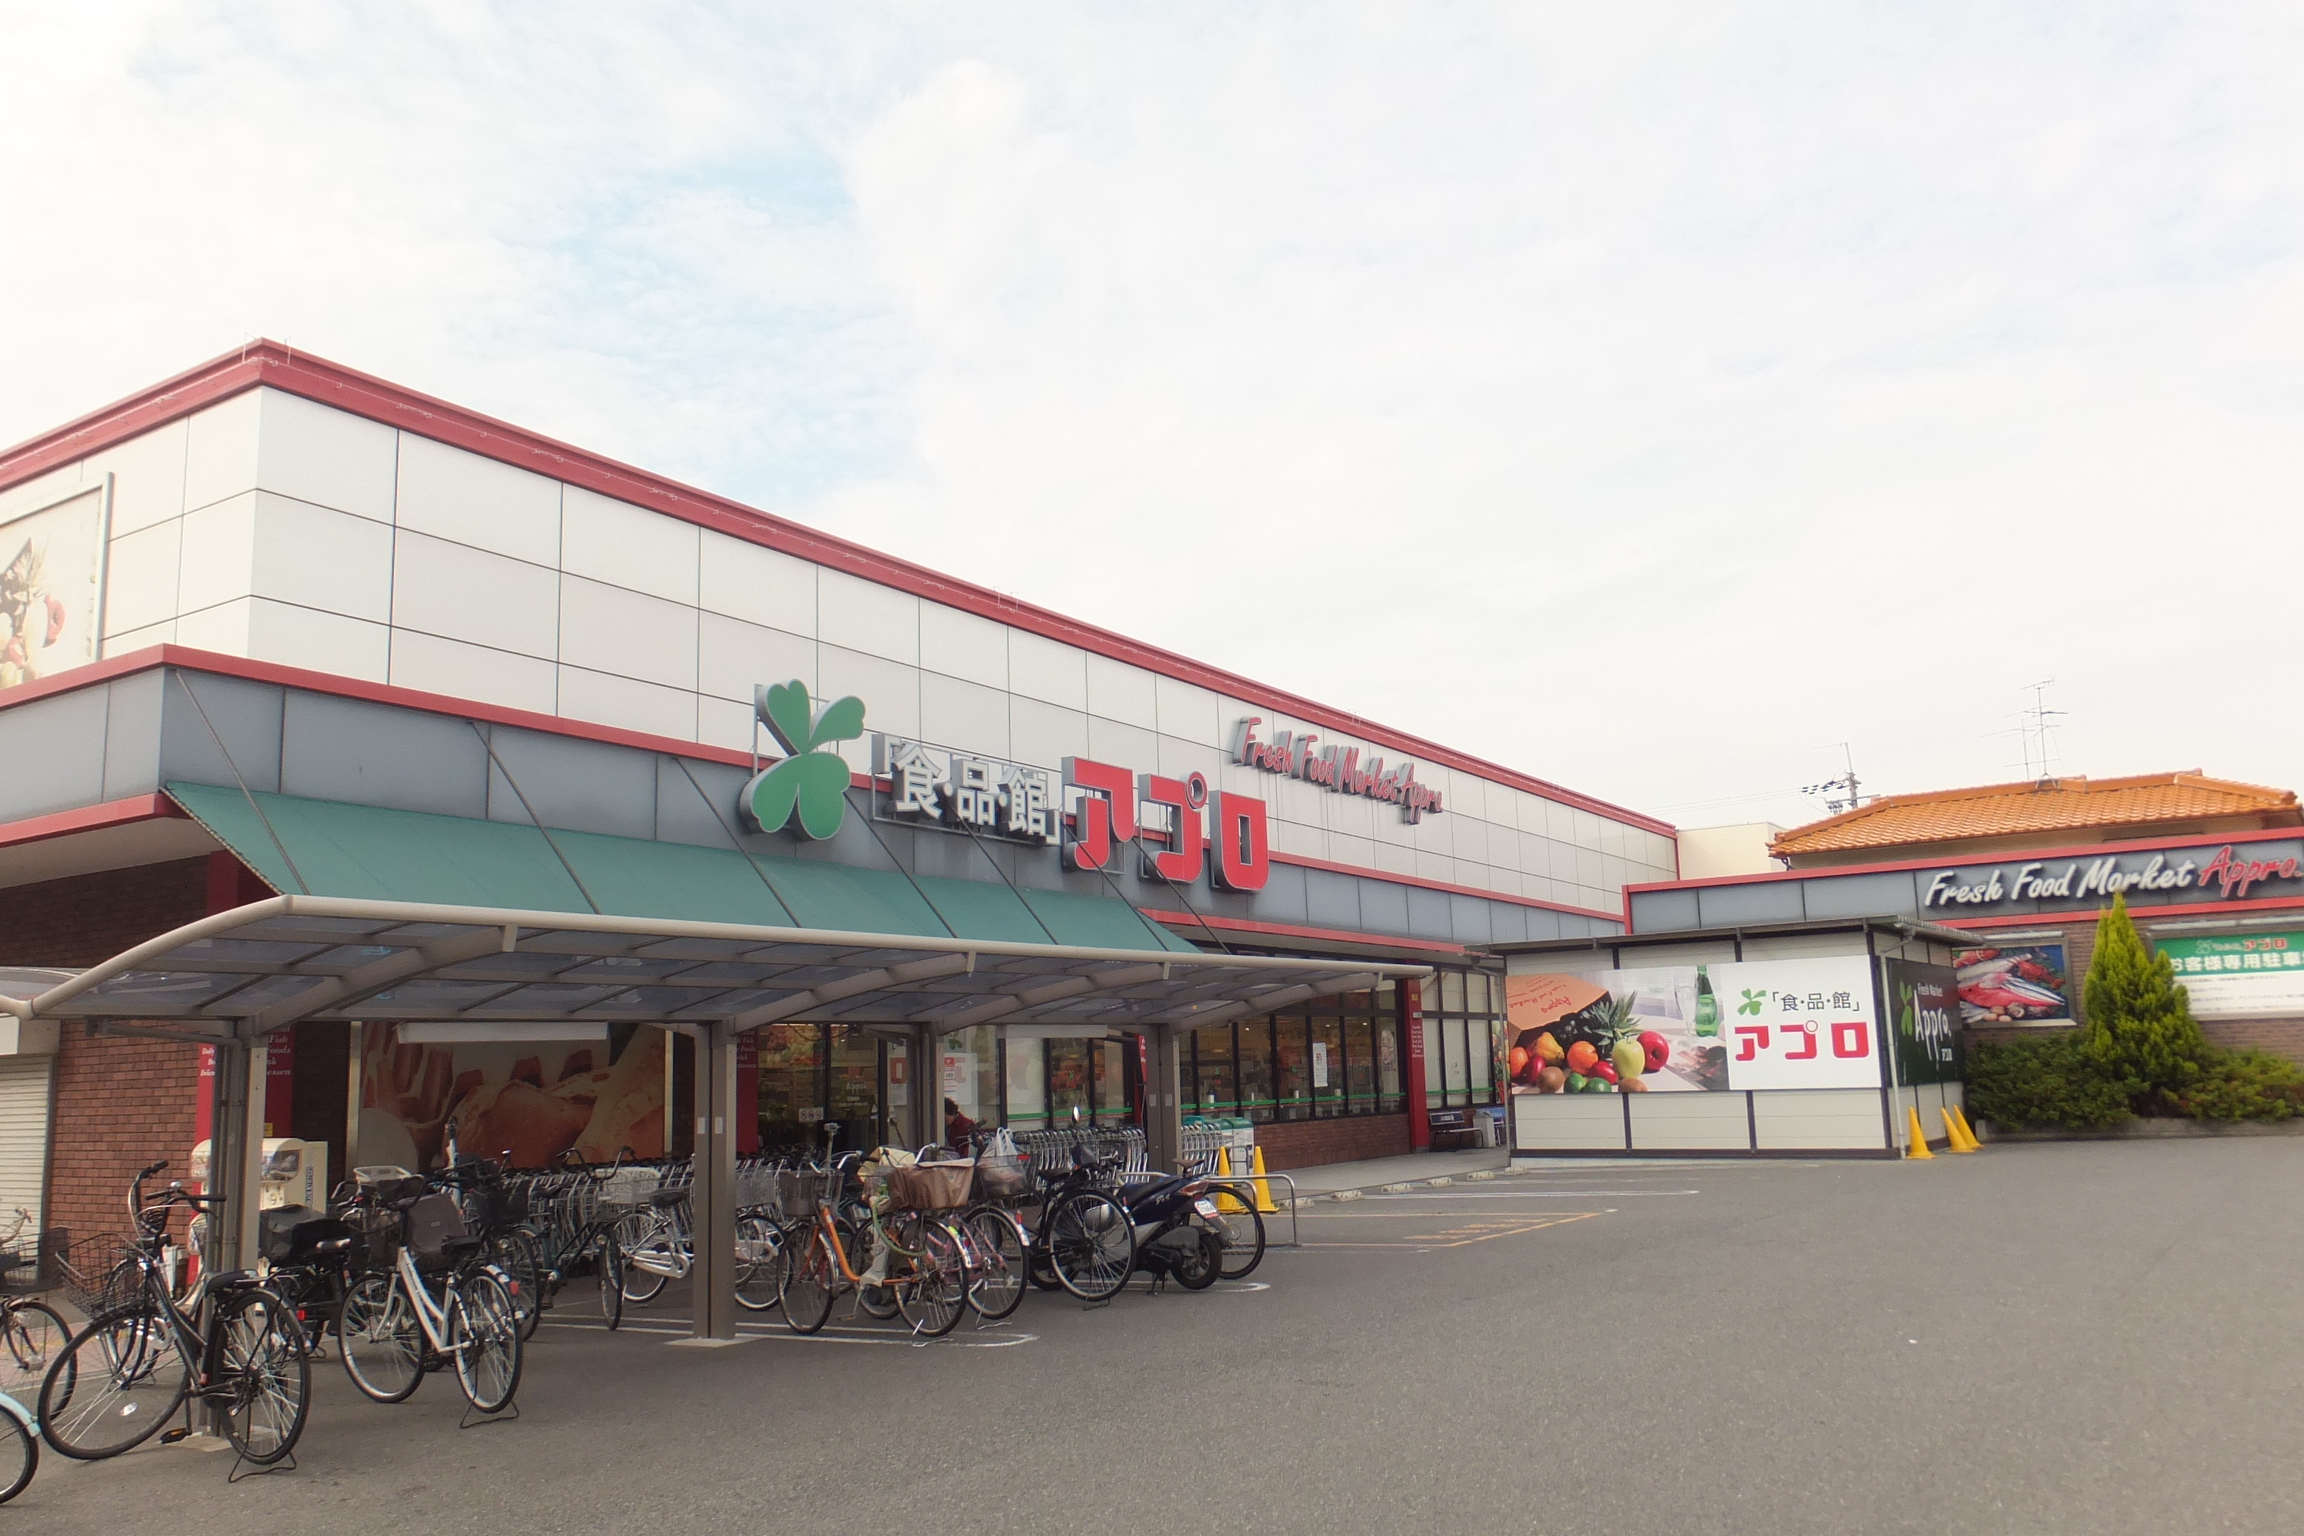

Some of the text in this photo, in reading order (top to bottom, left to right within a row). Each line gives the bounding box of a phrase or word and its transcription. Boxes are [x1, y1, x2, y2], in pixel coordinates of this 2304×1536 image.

[1236, 716, 1294, 774] Fresh
[1294, 734, 1338, 786] Food
[1333, 746, 1399, 801] Market
[1061, 756, 1270, 891] アプロ
[1924, 869, 2004, 907] Fresh
[2010, 861, 2077, 901] Food
[2075, 853, 2196, 899] Market
[2170, 951, 2304, 972] お客様専用駐車
[2242, 938, 2288, 952] アプロ
[1771, 990, 1861, 1012] 「食・品・館」
[1734, 1019, 1870, 1062] アプロ
